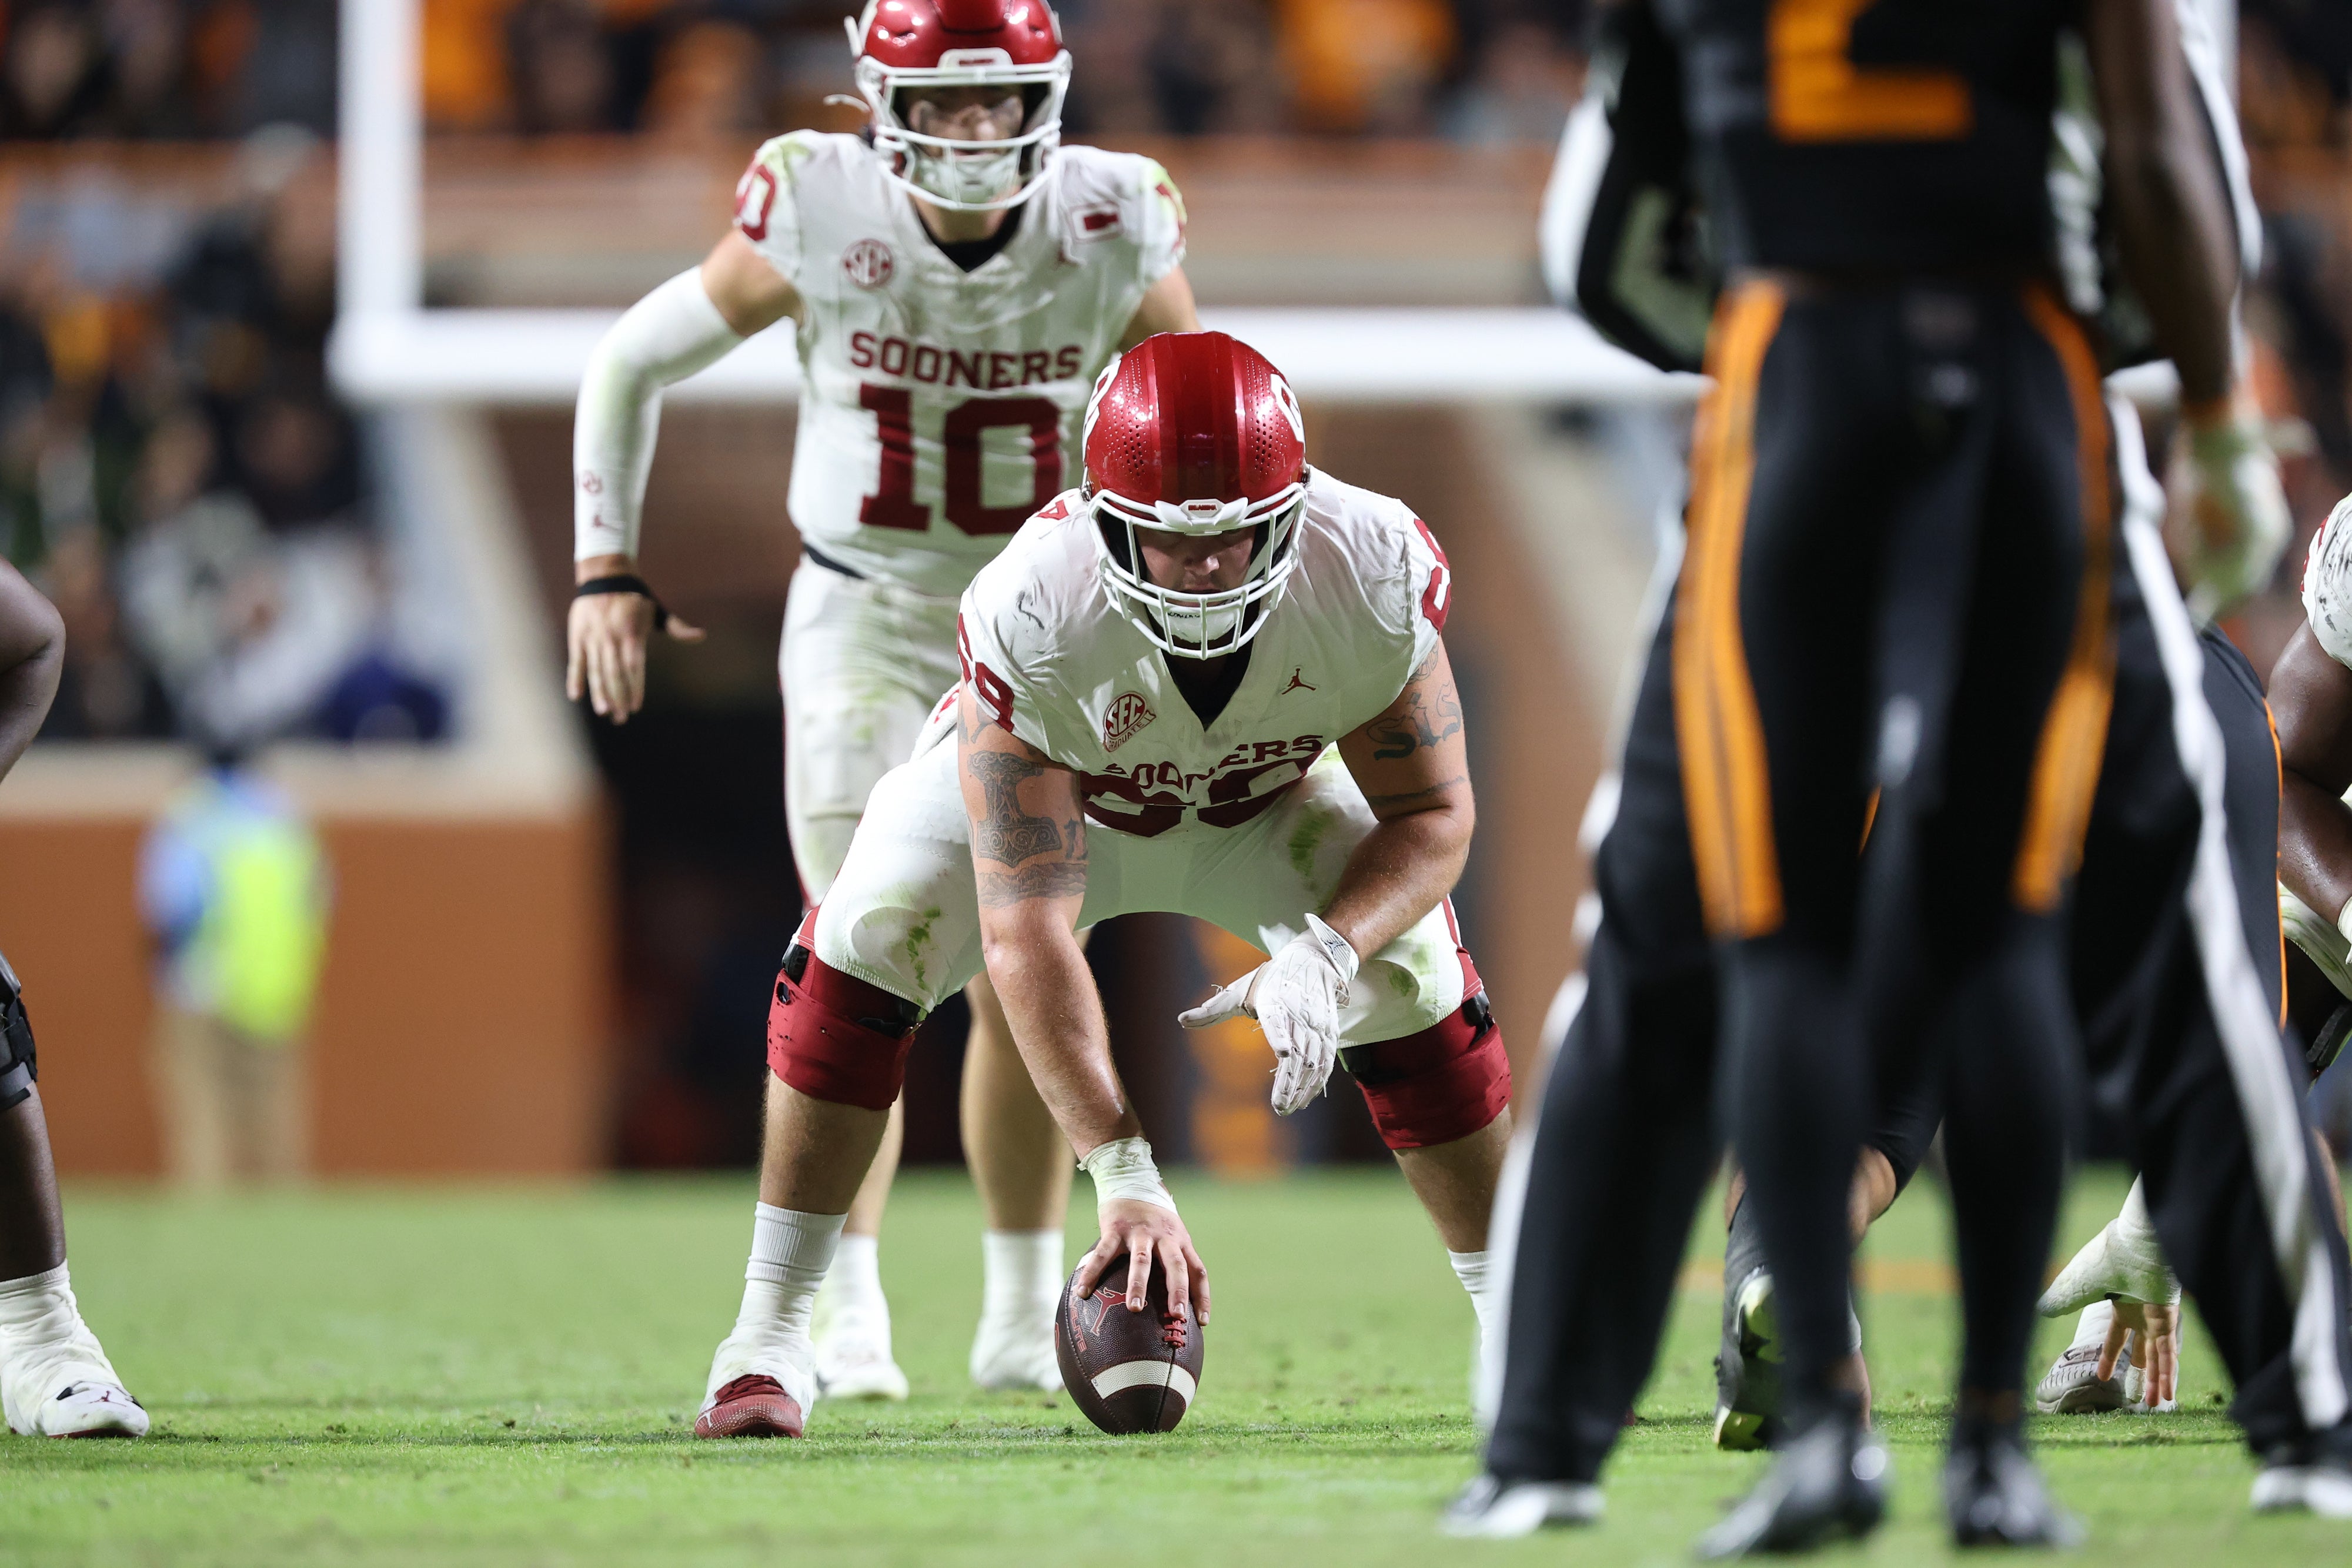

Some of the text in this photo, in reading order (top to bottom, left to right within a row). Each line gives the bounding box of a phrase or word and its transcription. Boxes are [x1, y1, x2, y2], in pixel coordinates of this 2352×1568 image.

[851, 331, 1083, 389] SOONERS
[859, 382, 1063, 537] 10
[1105, 694, 1144, 734] SEC
